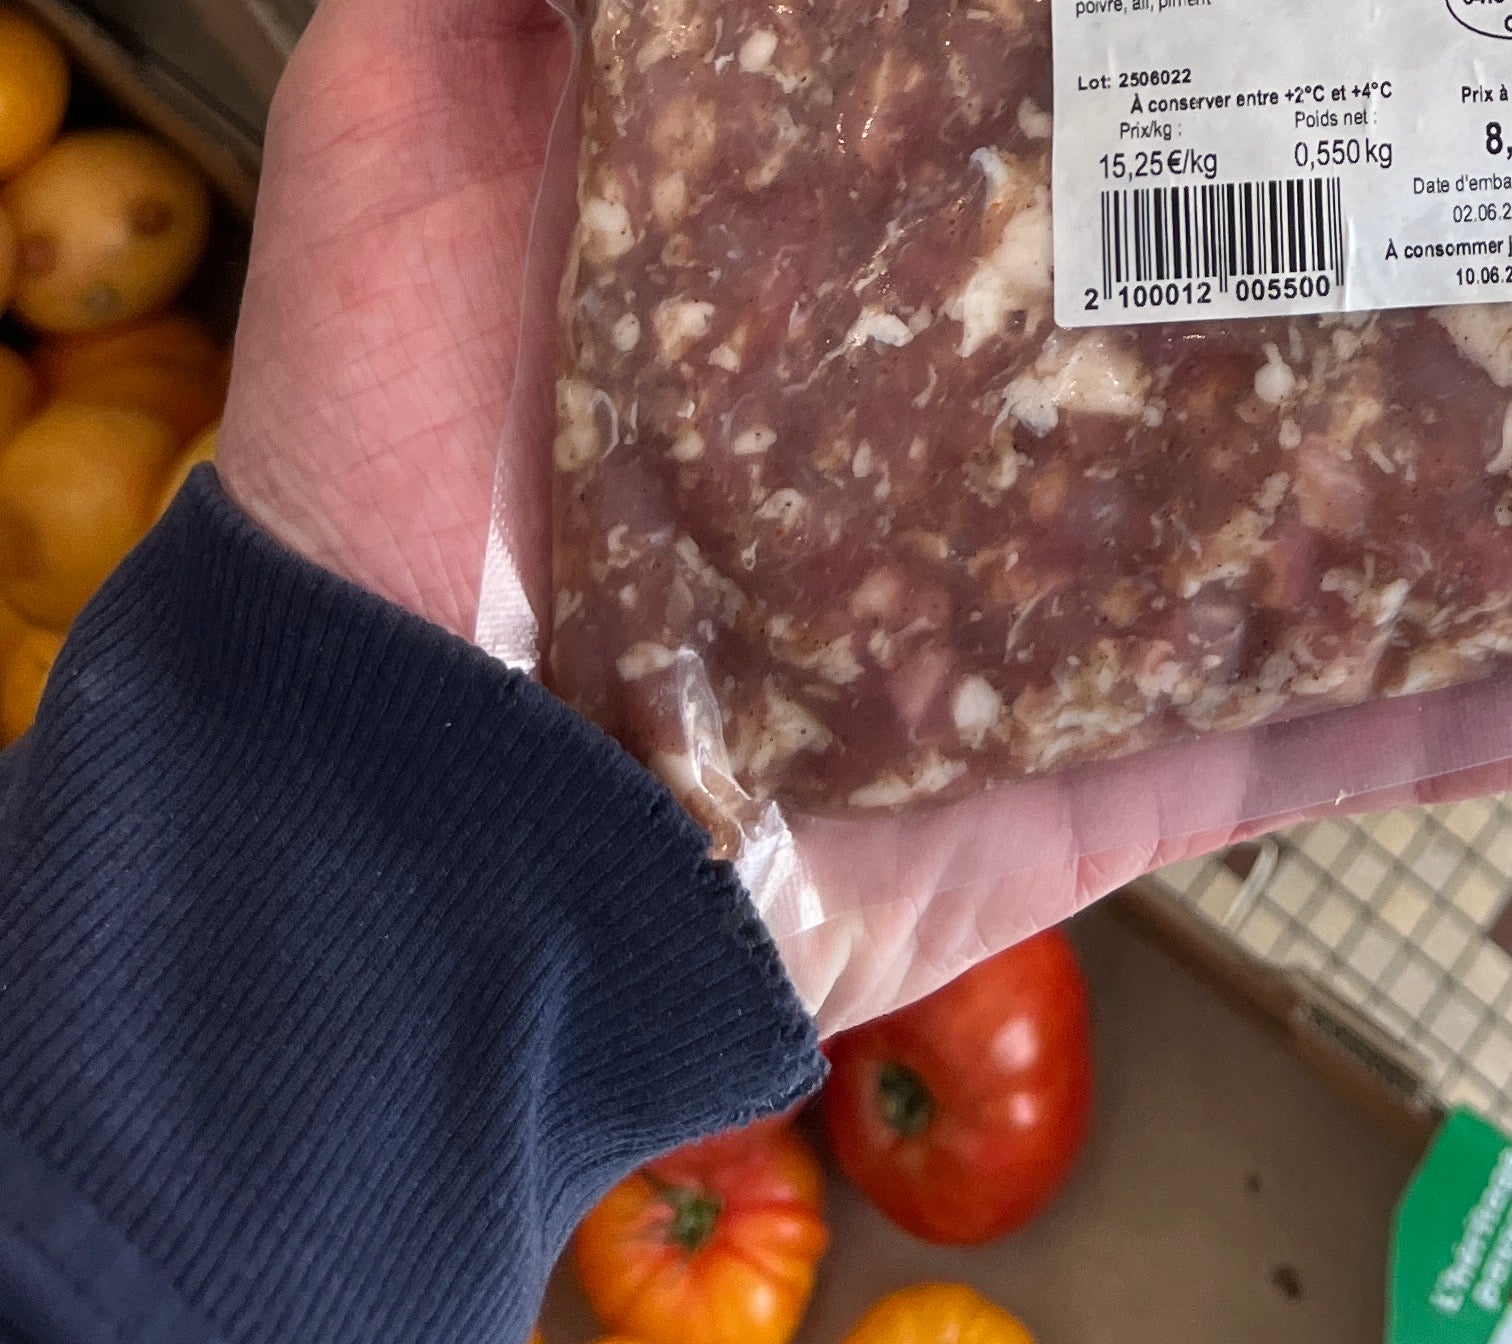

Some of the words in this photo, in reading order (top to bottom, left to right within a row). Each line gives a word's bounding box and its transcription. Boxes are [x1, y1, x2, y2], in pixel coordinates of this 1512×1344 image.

[1078, 74, 1112, 91] Lot:
[1118, 68, 1193, 89] 2506022
[1148, 93, 1231, 113] conserver
[1236, 88, 1279, 107] entre
[1284, 83, 1326, 104] +2°C
[1331, 84, 1347, 102] et
[1351, 80, 1393, 100] +4°C
[1461, 85, 1493, 105] Prix
[1499, 83, 1509, 102] à
[1295, 109, 1339, 129] Poids
[1343, 107, 1368, 126] net
[1120, 120, 1173, 141] Prix/kg
[1413, 175, 1450, 196] Date
[1404, 238, 1504, 259] consommer
[1084, 287, 1099, 310] 2
[1118, 281, 1212, 308] 100012
[1235, 275, 1331, 301] 005500
